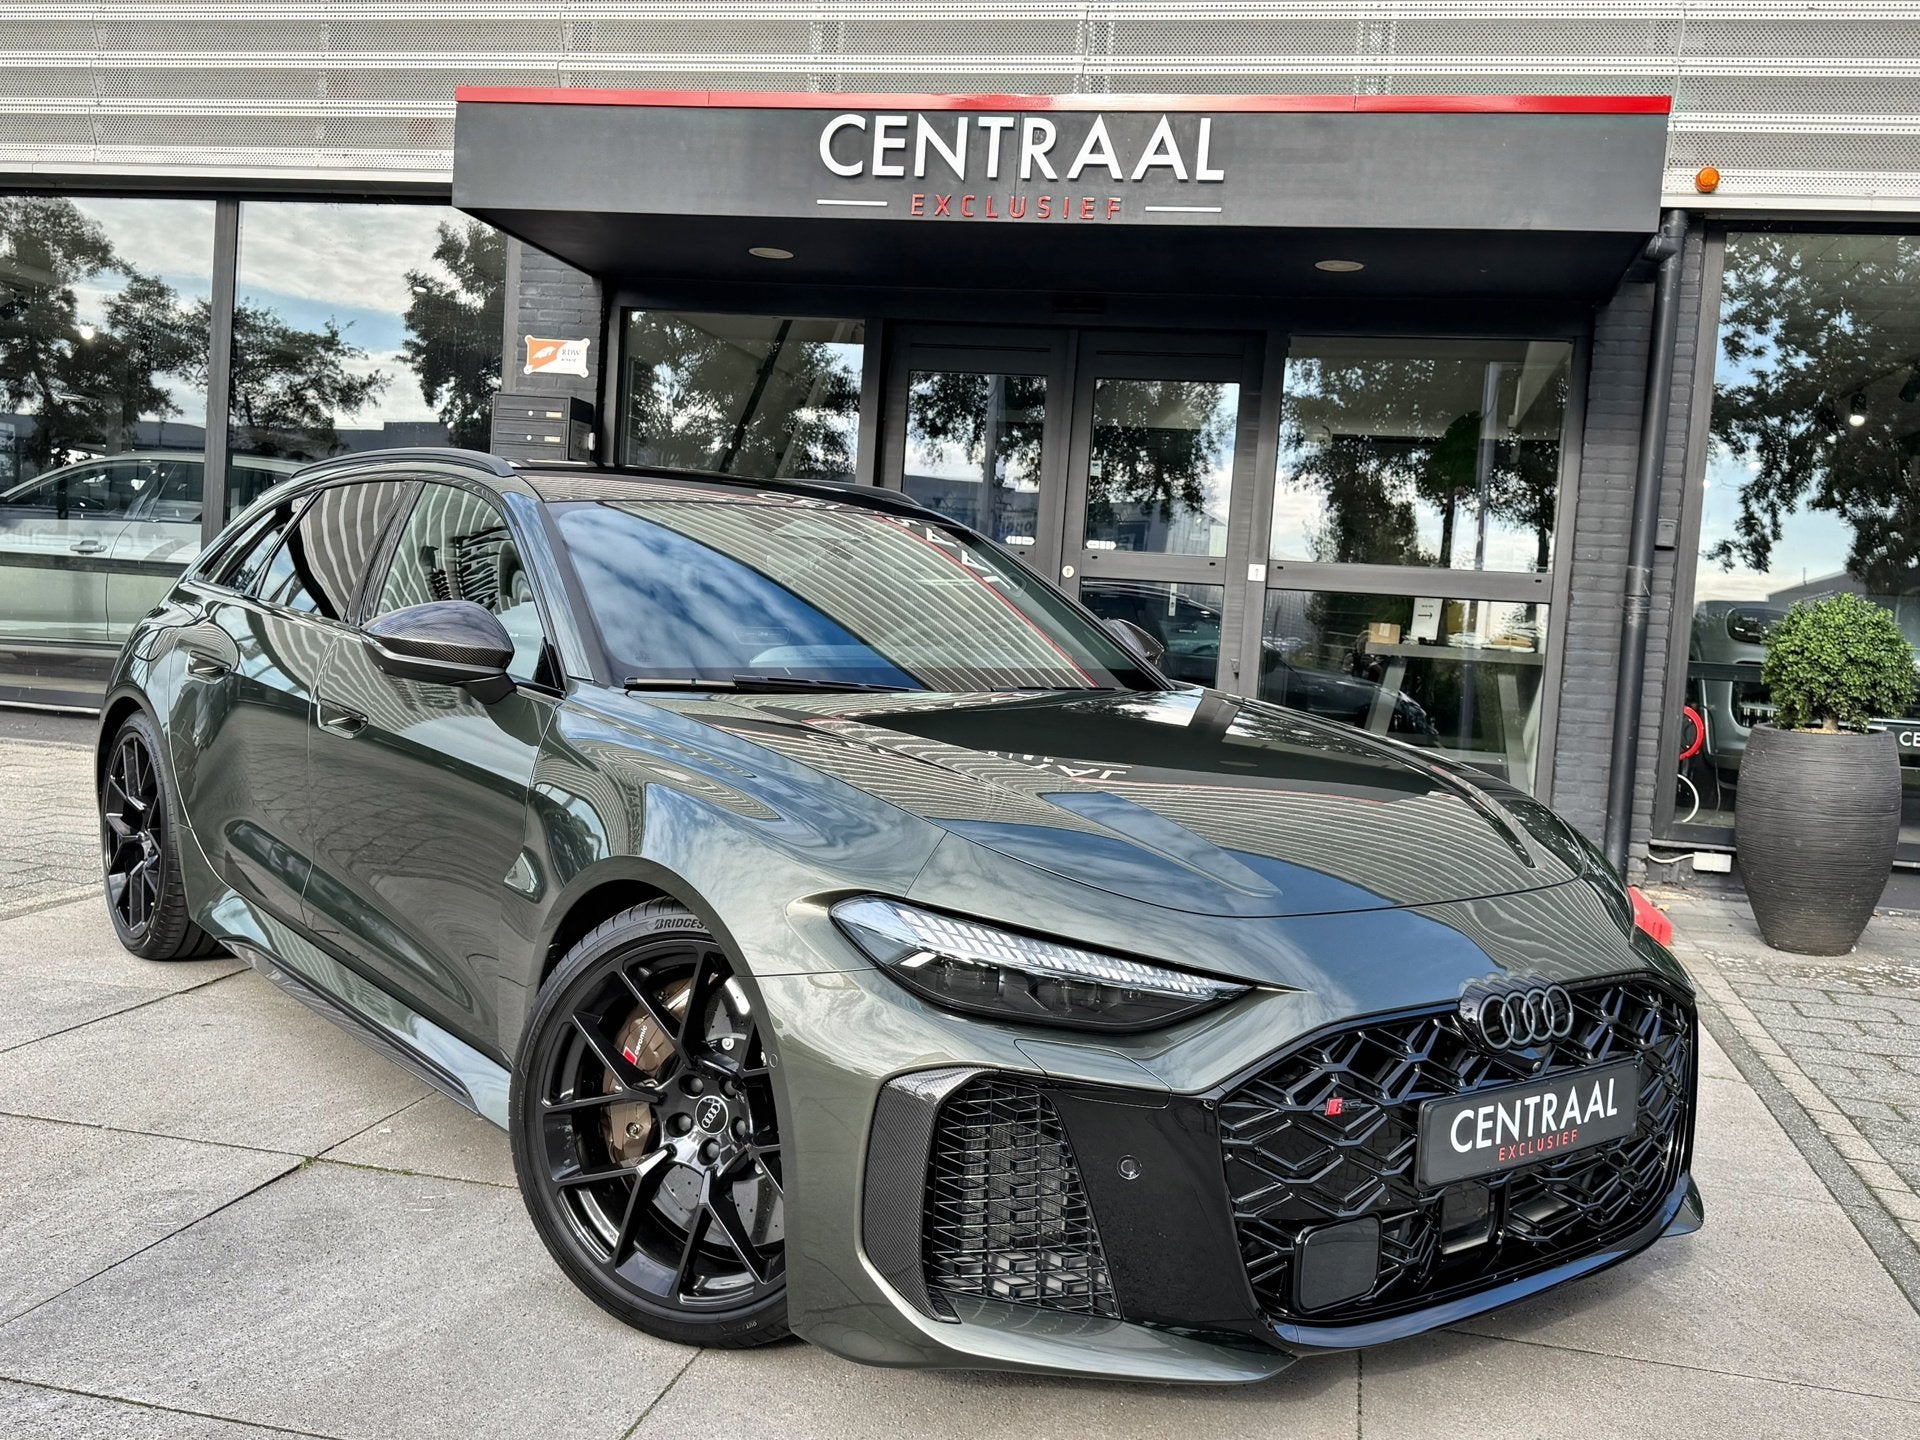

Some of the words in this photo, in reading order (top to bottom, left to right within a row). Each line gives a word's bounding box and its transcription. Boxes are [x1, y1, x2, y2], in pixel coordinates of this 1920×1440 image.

[819, 113, 1225, 181] CENTRAAL
[910, 193, 1122, 220] EXCLUSIEF
[654, 918, 707, 930] BRIDGES
[634, 1024, 648, 1056] ceramic
[1450, 1077, 1618, 1153] CENTRAAL
[1498, 1129, 1579, 1162] EXCLUSIEF
